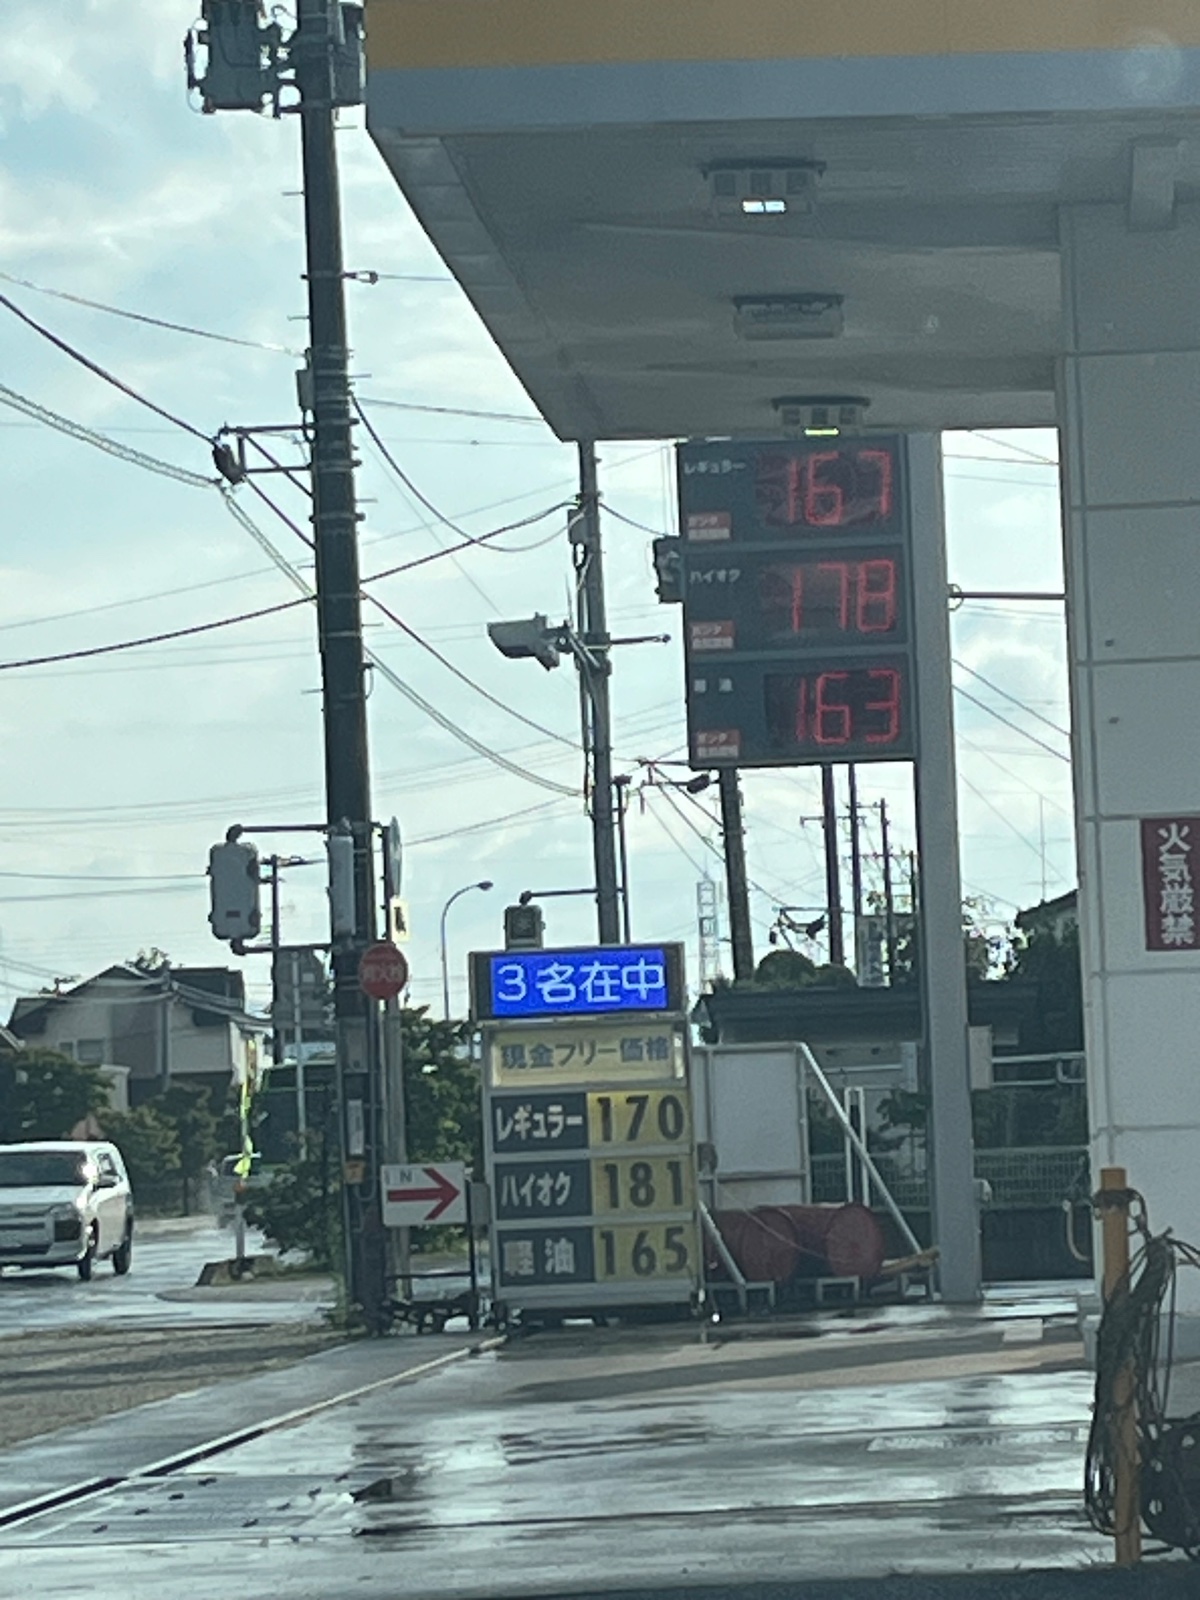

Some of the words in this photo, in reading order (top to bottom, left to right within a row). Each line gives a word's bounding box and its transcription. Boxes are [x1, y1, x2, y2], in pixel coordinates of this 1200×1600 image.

[788, 450, 892, 526] 167
[792, 559, 896, 633] 178
[797, 669, 901, 745] 163
[496, 1103, 583, 1141] レギュラー
[597, 1094, 685, 1142] 170
[500, 1171, 571, 1208] ハイオク
[603, 1160, 684, 1208] 181
[600, 1226, 688, 1276] 165
